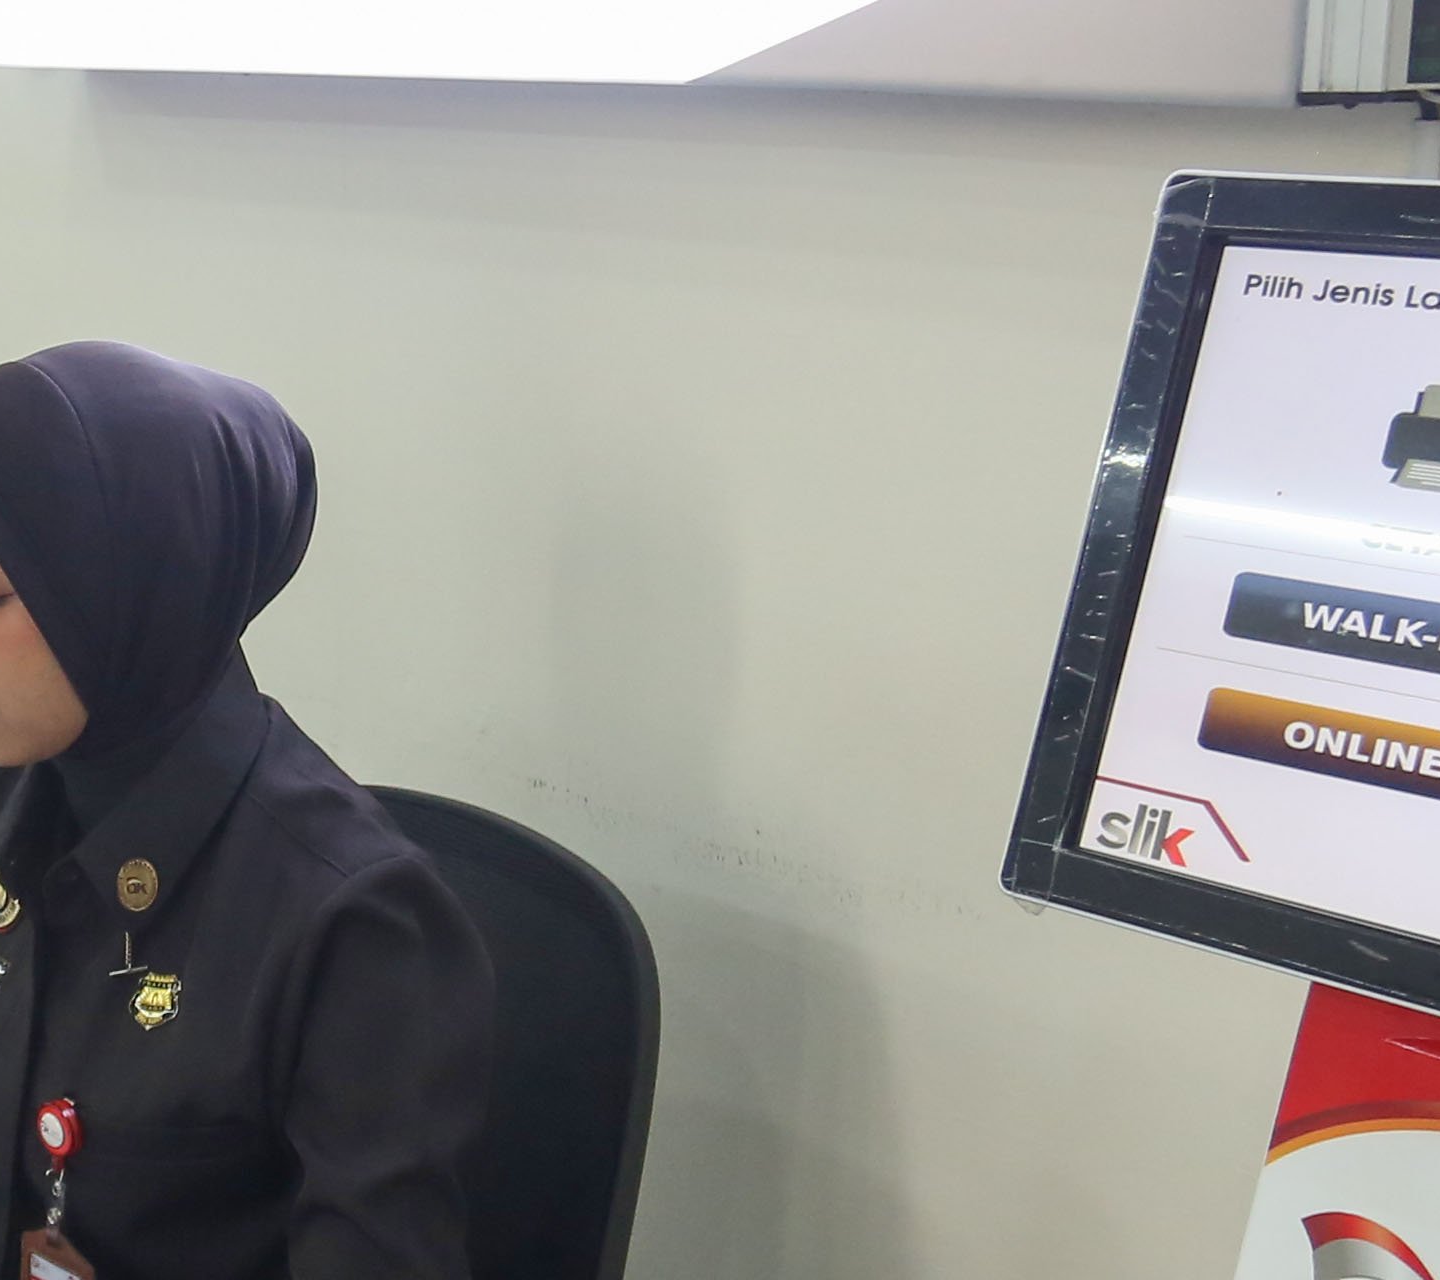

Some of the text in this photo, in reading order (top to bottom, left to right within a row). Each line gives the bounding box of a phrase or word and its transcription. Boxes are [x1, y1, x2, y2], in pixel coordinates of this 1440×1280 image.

[1243, 274, 1304, 299] Pilih
[1312, 279, 1394, 306] Jenis
[1096, 803, 1195, 867] slik
